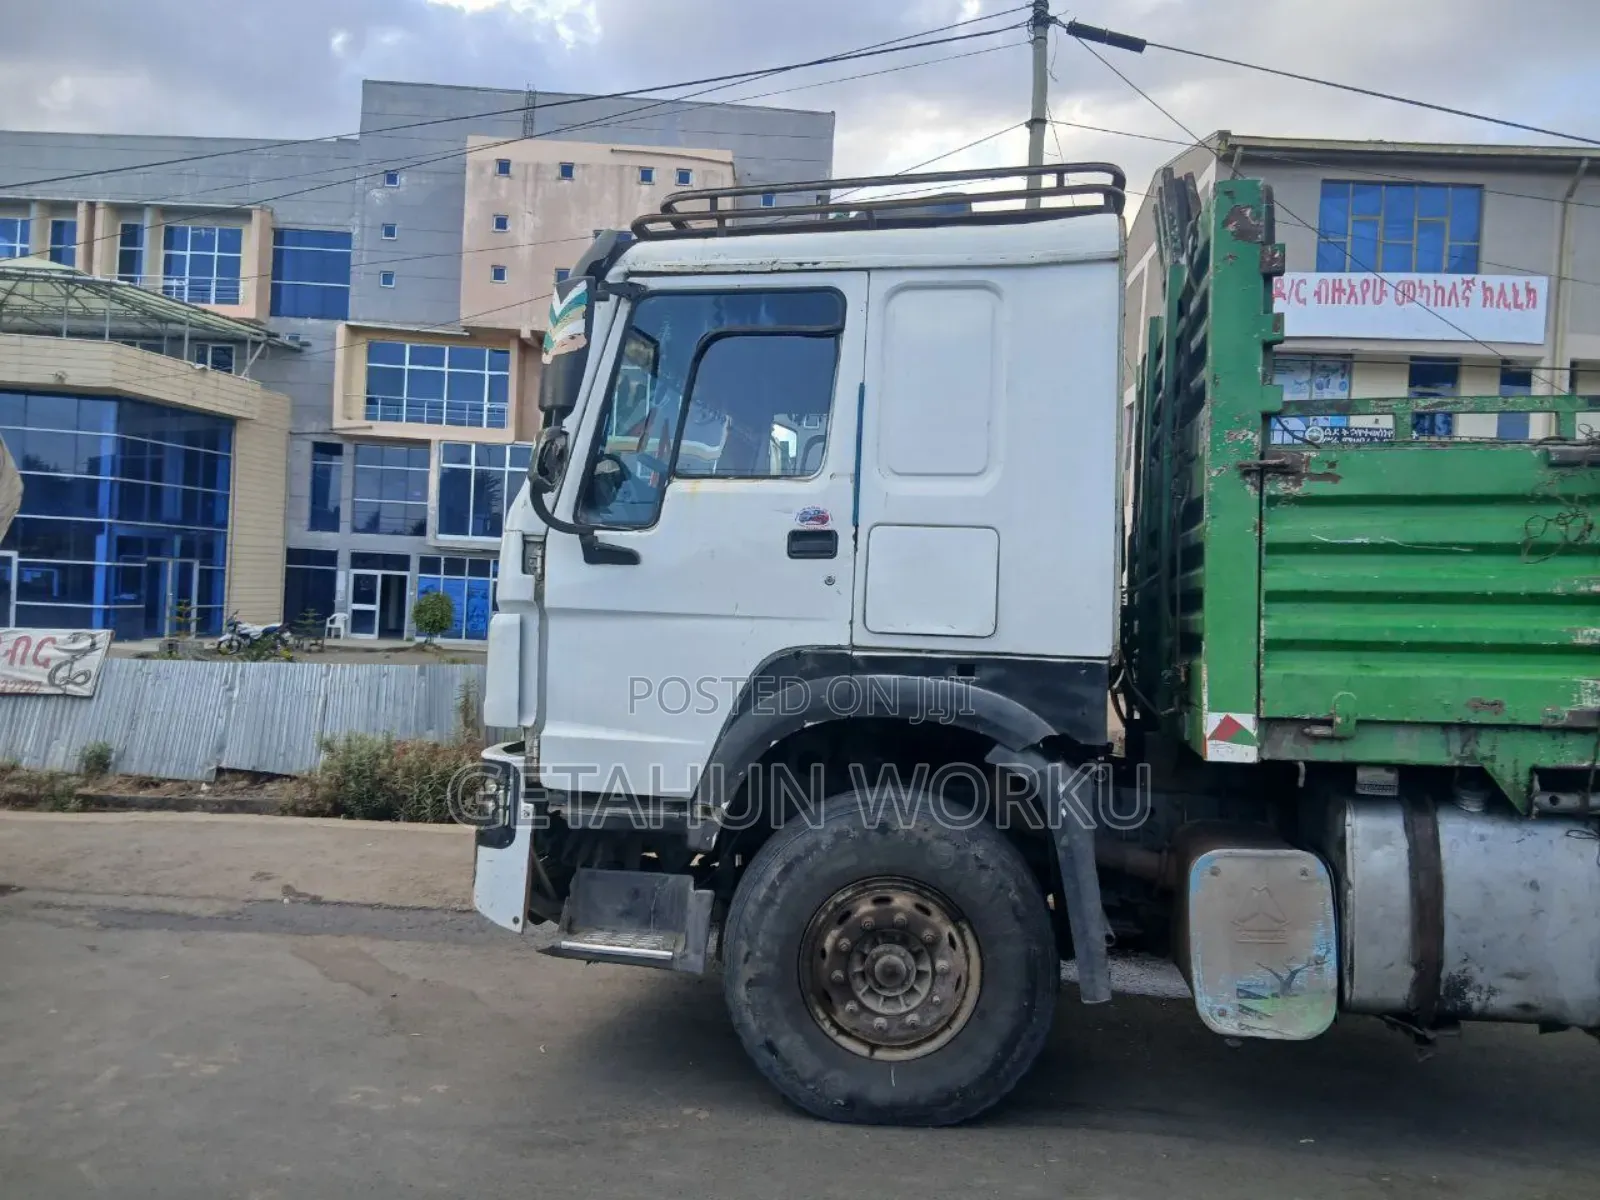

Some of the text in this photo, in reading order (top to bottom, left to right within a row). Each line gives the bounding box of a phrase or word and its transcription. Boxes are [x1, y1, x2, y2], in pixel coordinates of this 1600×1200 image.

[1394, 277, 1476, 308] መካከለኛ
[1481, 280, 1537, 311] ክሊኒክ
[0, 632, 57, 669] ብር
